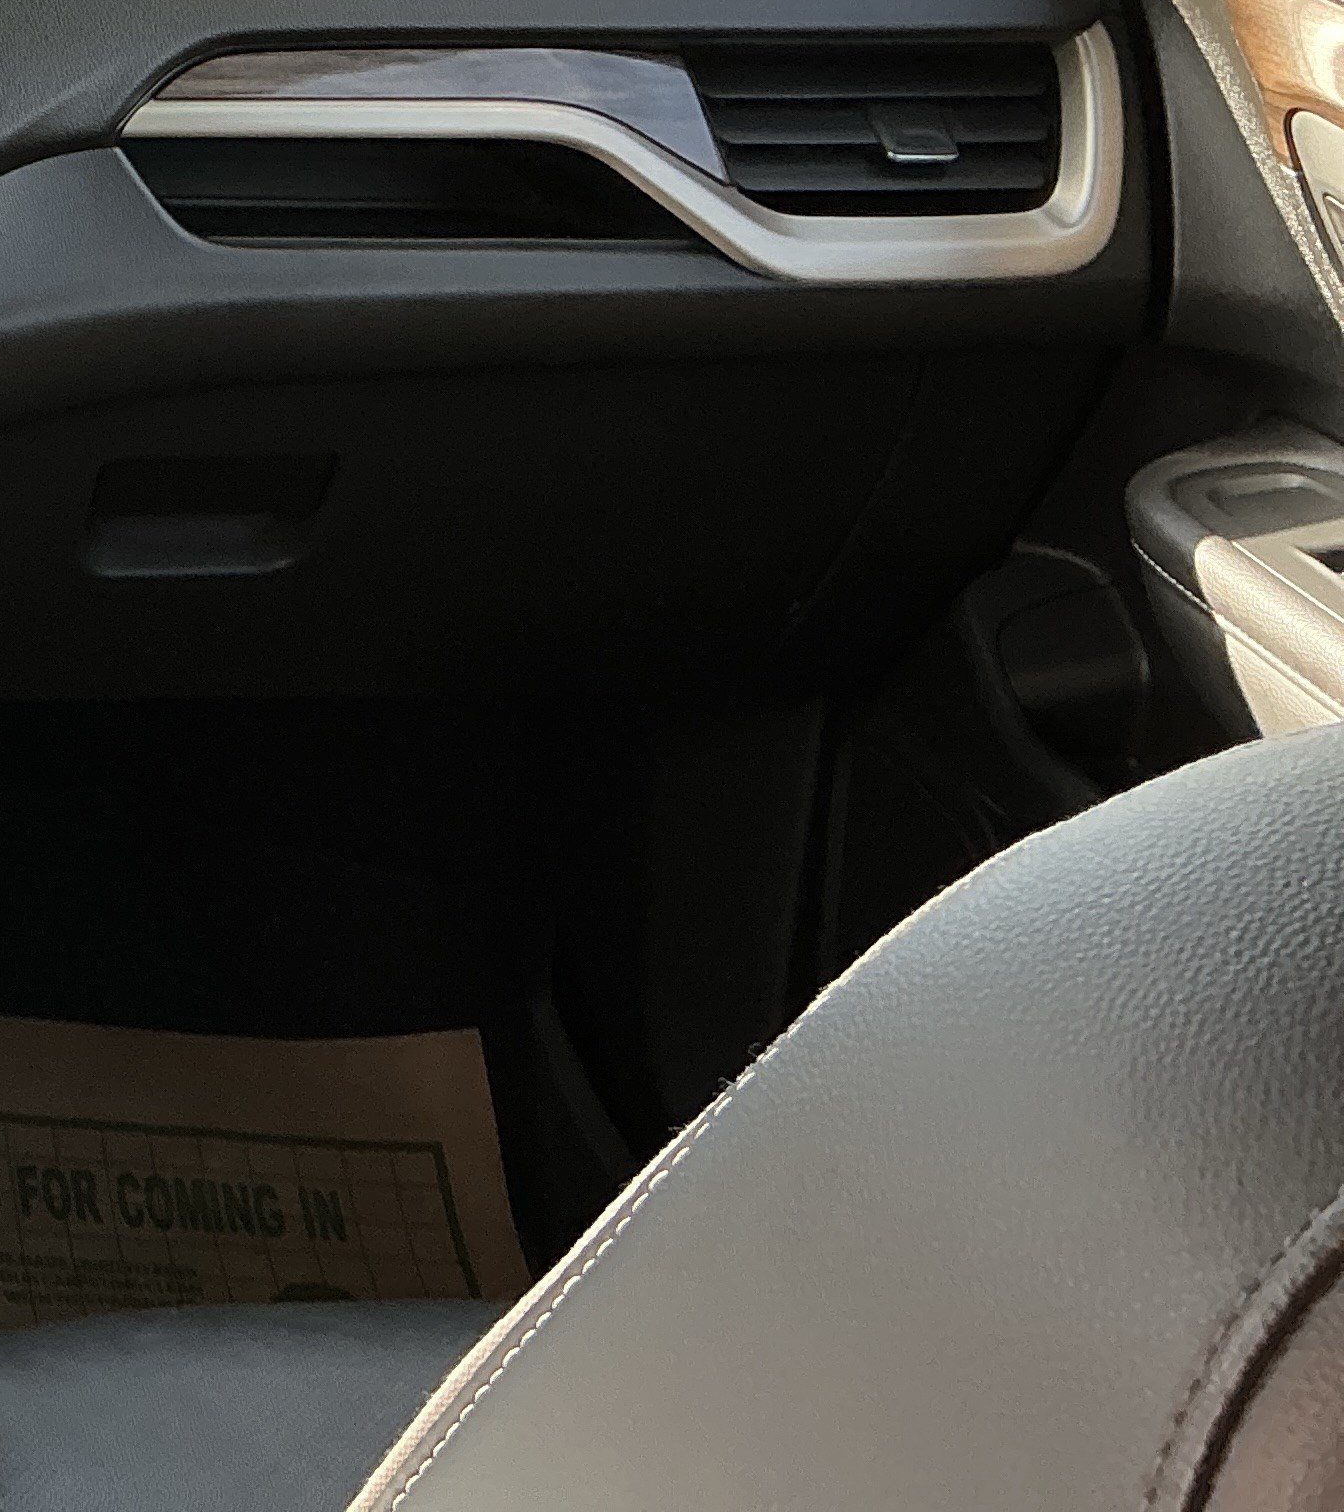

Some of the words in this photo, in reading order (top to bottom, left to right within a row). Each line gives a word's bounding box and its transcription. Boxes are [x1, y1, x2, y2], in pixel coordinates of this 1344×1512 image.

[15, 1162, 106, 1225] FOR
[115, 1170, 288, 1240] COMING
[296, 1184, 349, 1244] IN
